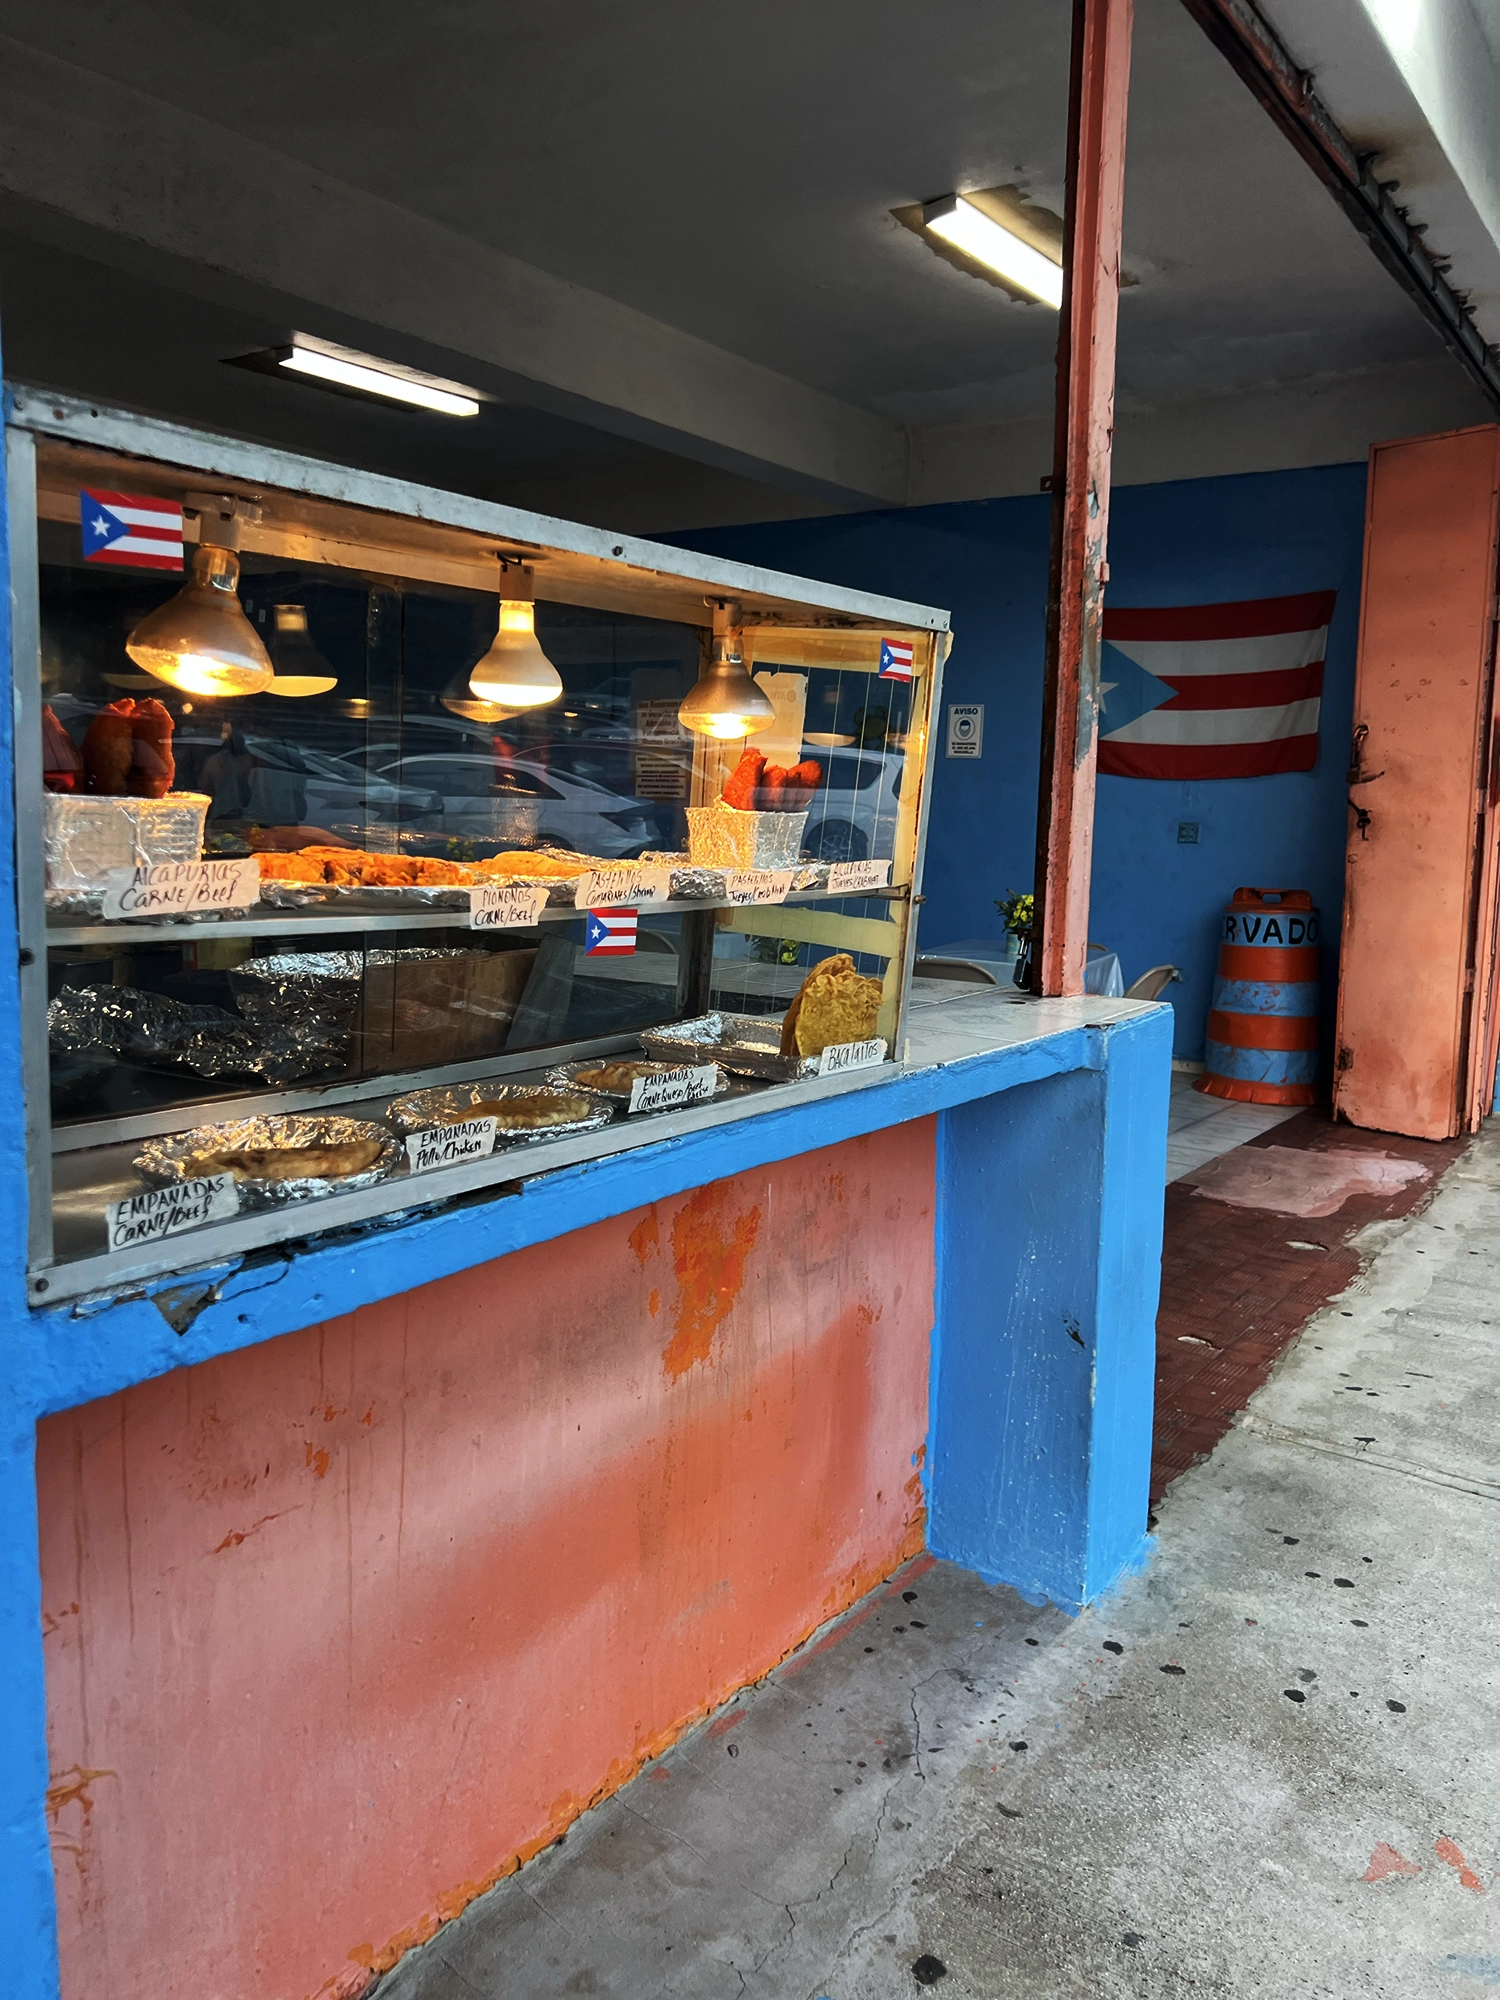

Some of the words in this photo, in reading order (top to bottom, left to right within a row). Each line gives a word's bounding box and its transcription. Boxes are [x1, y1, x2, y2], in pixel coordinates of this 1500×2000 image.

[954, 707, 979, 716] AVISO
[483, 888, 531, 907] PIONONOS
[642, 1070, 695, 1092] EMPANADAS
[117, 1177, 224, 1225] EMPANADAS
